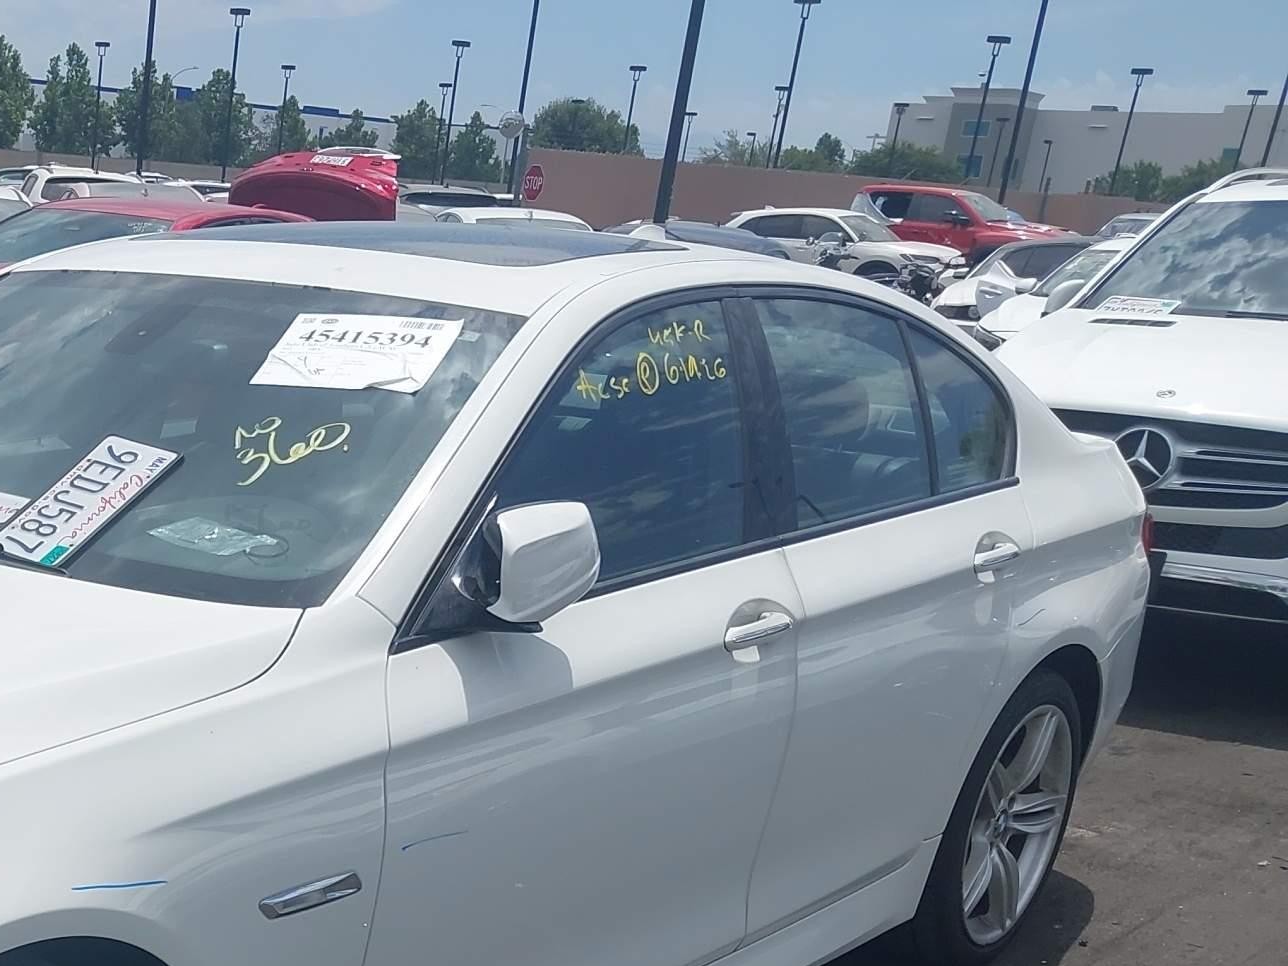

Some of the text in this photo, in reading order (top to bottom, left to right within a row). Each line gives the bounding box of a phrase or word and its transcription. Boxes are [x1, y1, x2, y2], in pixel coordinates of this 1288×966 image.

[524, 175, 543, 190] STOP
[299, 329, 432, 348] 45415394
[145, 456, 168, 474] MAY
[5, 445, 139, 554] 9EDJ587
[57, 474, 144, 546] California
